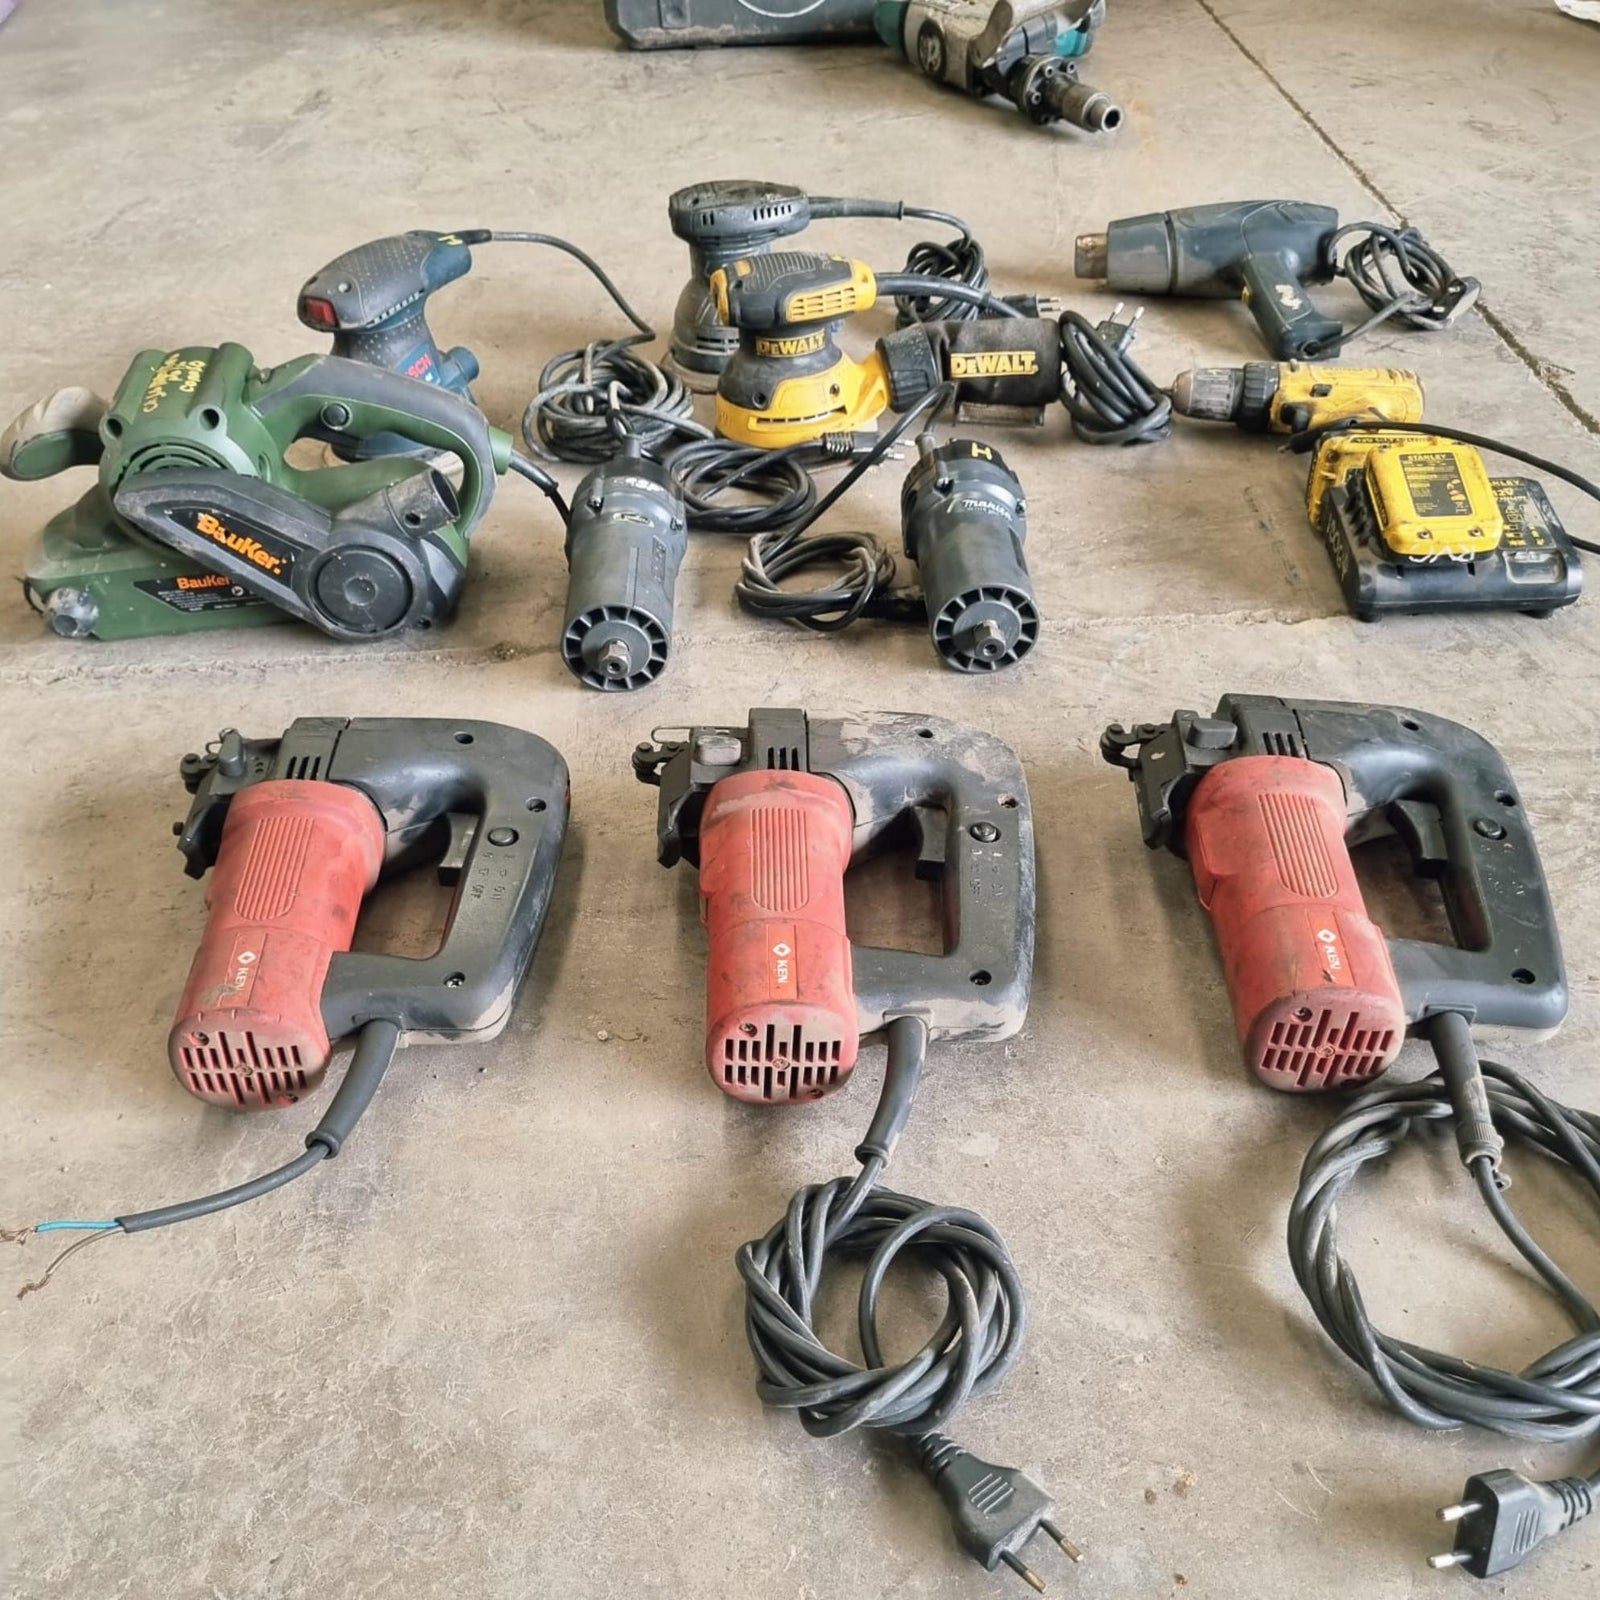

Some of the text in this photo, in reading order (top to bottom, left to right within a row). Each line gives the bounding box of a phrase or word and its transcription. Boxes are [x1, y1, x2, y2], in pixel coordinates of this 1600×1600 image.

[757, 333, 825, 355] DEWALT
[407, 352, 432, 378] SCH
[950, 354, 1036, 375] DEWALT
[776, 959, 789, 984] KEN
